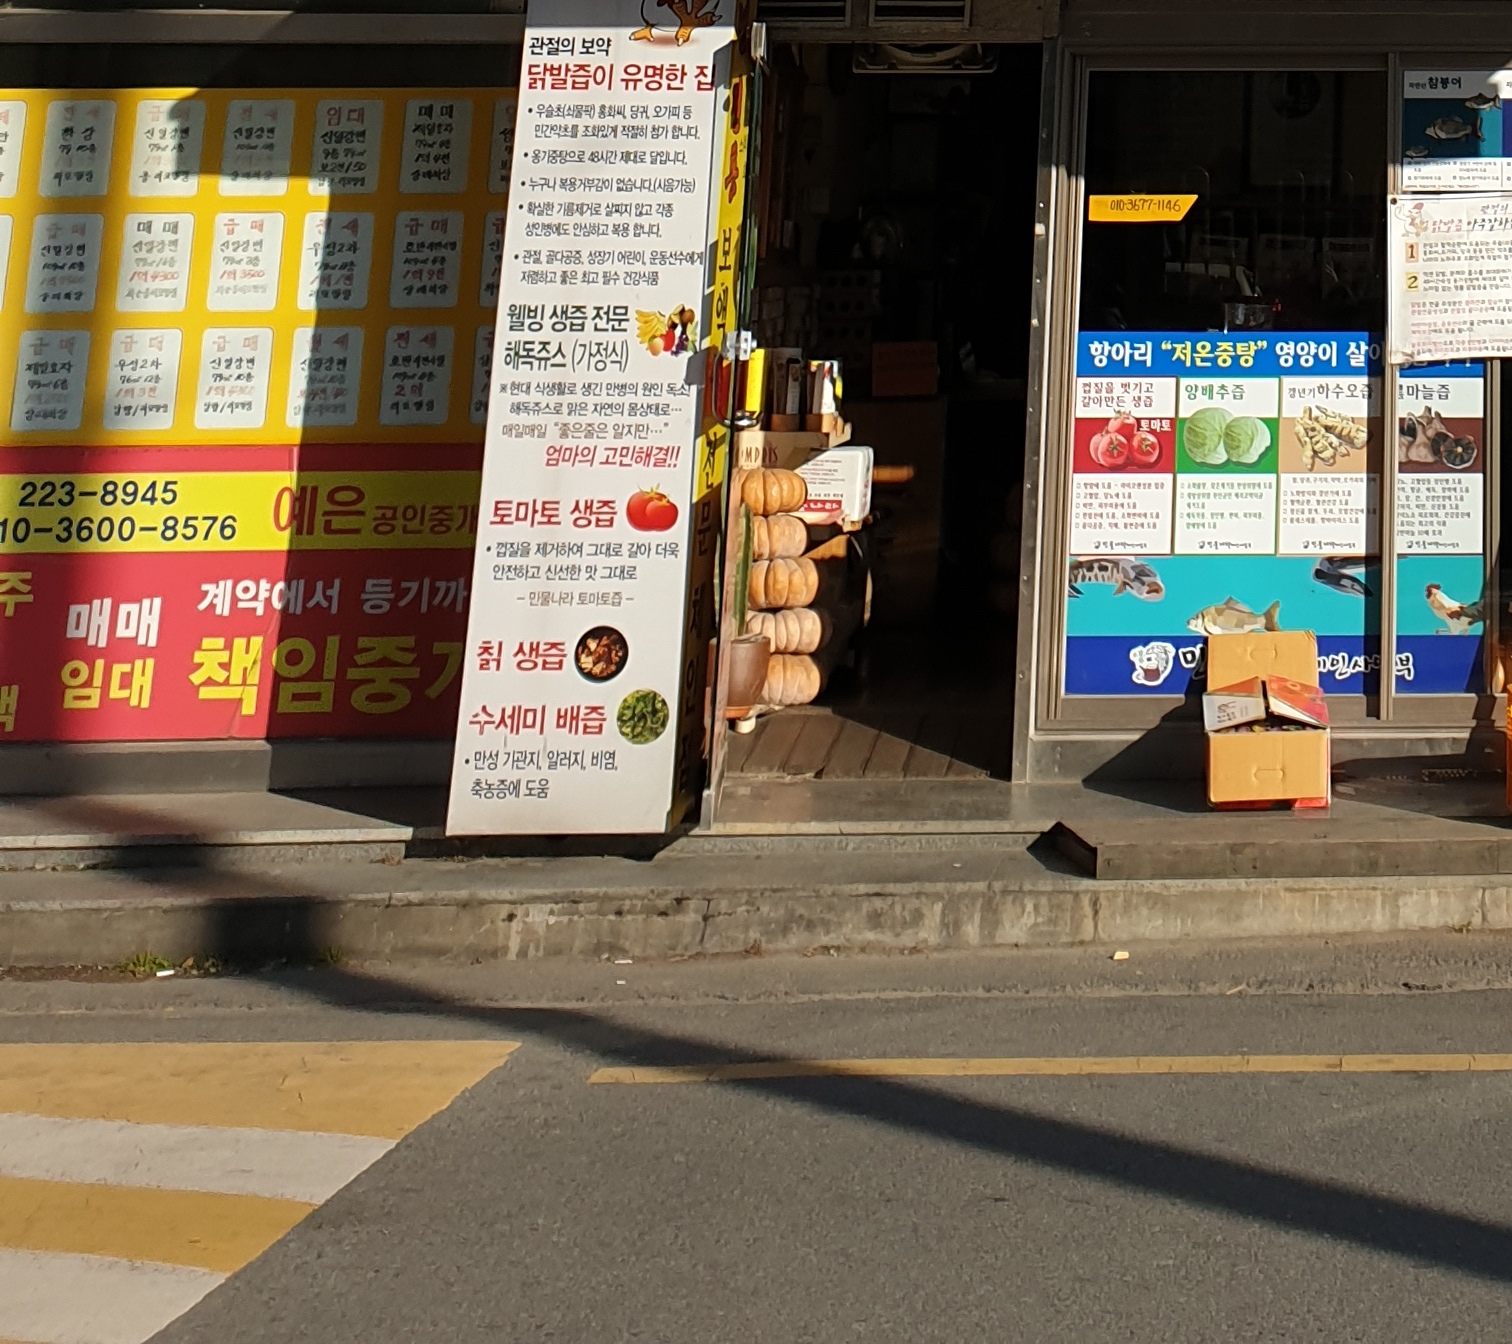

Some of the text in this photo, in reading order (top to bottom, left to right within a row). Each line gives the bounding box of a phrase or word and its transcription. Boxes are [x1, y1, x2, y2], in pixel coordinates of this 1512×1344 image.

[529, 37, 612, 56] 관절의 보약
[528, 63, 715, 91] 닭발즙이 유명한 집
[653, 105, 692, 119] 오가피 등
[534, 124, 700, 140] 민간약초를 조화있게 적절히 첨가 합니다.
[532, 150, 687, 165] 옹기중탕으로 48시간 제대로 달입니다.
[529, 177, 614, 193] 누구나 복용거부감이
[527, 202, 555, 217] 확실한
[557, 202, 601, 217] 기름제거로
[635, 203, 652, 217] 않고
[656, 203, 674, 217] 각종
[525, 223, 662, 238] 성인병에도 안심하고 복용 합니다.
[587, 250, 615, 265] 성장기
[649, 251, 704, 266] 운동선수에게
[1409, 244, 1415, 259] 1
[520, 270, 659, 286] 저렴하고 좋은 최고 필수 건강식품
[1408, 275, 1419, 289] 2
[507, 304, 630, 332] 웰빙 생즙 전문
[504, 339, 629, 372] 해독쥬스 (가정식)
[1089, 340, 1152, 367] 항아리
[1275, 341, 1337, 367] 영양이
[535, 382, 663, 397] 식생활로 생긴 만병의 원인
[1081, 382, 1154, 394] 껍질을 벗기고
[1185, 383, 1245, 401] 양배추즙
[510, 402, 624, 416] 해독쥬스로 맑은 자연의
[1081, 395, 1153, 408] 갈아만든 생즙
[502, 423, 547, 438] 매일매일
[1140, 419, 1171, 432] 토마토
[545, 445, 681, 468] 엄마의 고민해결!!
[18, 480, 179, 508] 223-8945
[273, 484, 366, 537] 예은
[489, 499, 617, 528] 토마토 생즙
[495, 542, 679, 558] 껍질을 제거하여 그대로 갈아 더욱
[492, 565, 637, 581] 안전하고 신선한 맛 그대로
[197, 578, 468, 616] 계약에서 등기까
[66, 596, 162, 648] 매매
[476, 641, 567, 671] 칡 생즙
[61, 658, 155, 709] 임대
[468, 705, 607, 735] 수세미 배즙
[474, 751, 499, 770] 만성
[471, 779, 550, 799] 축농증에 도움
